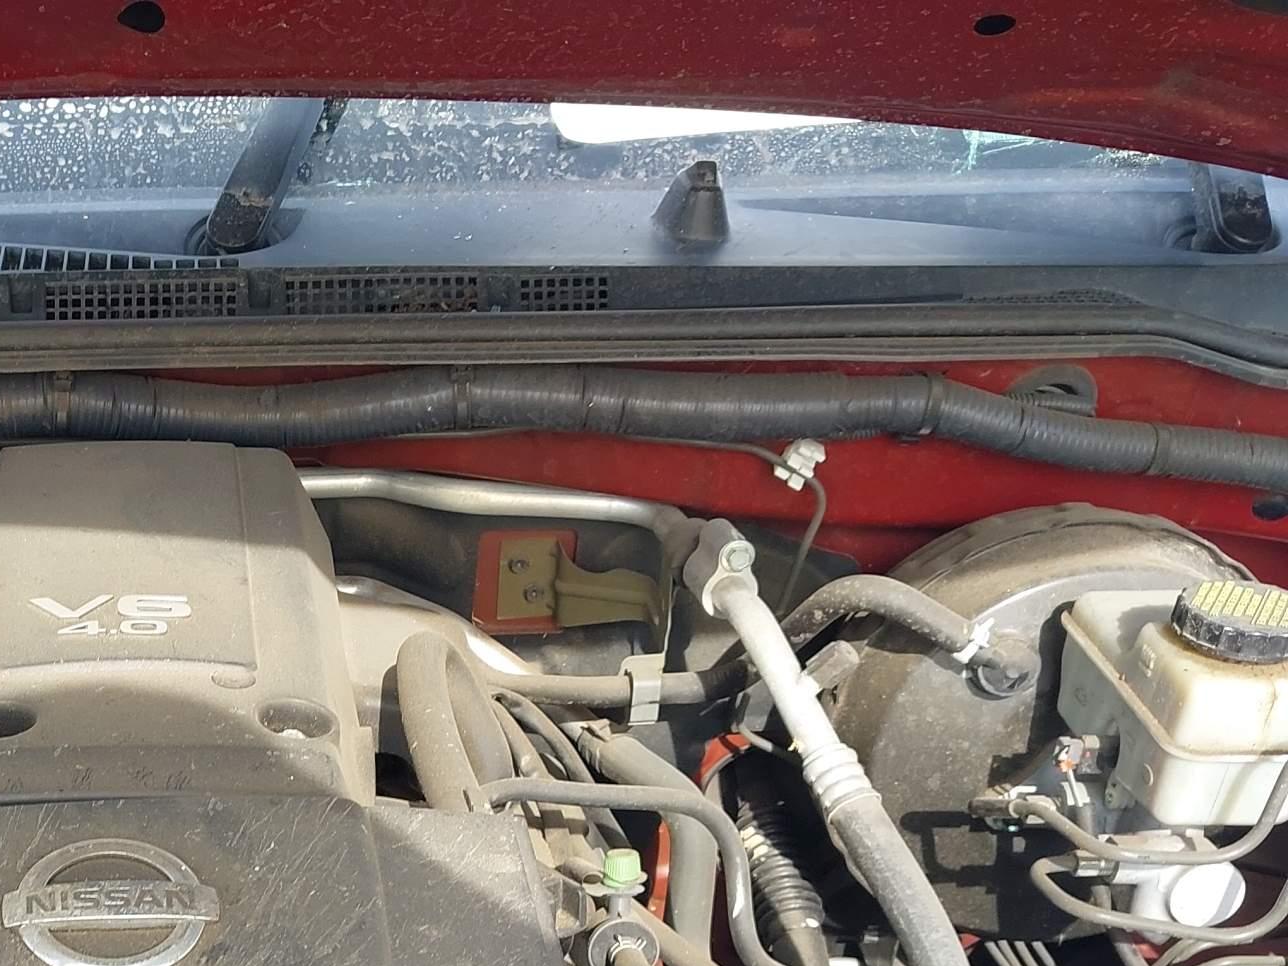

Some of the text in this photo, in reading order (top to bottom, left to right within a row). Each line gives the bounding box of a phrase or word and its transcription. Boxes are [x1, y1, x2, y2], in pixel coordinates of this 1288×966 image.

[28, 593, 192, 619] V6
[57, 619, 168, 636] 4.0
[25, 886, 196, 915] NISSAN
